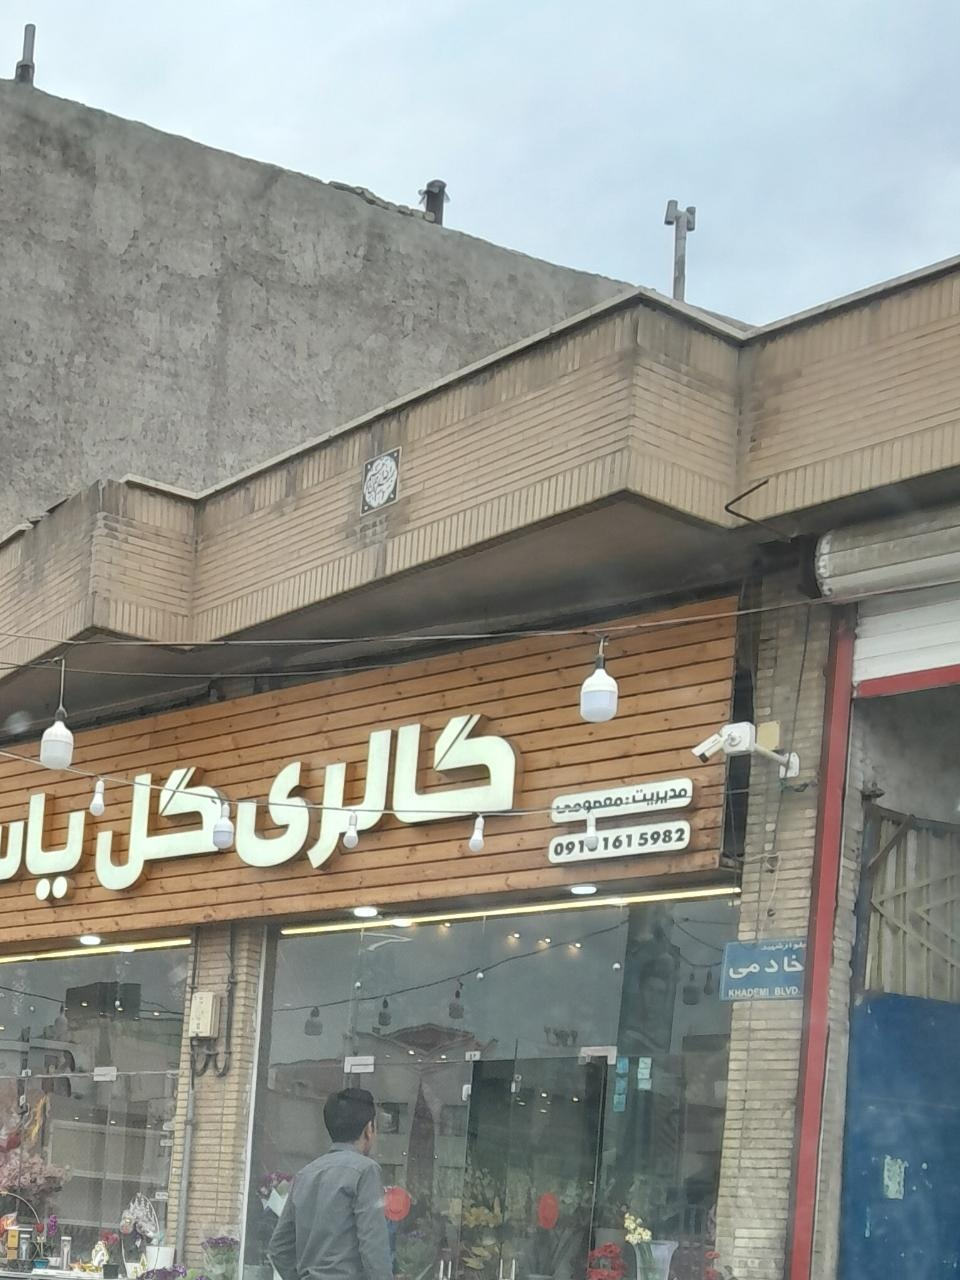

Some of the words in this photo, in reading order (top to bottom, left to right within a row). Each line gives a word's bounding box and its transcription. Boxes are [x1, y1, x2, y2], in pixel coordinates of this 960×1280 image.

[95, 766, 227, 890] گل
[235, 714, 518, 869] گالری
[729, 954, 805, 979] خادمی
